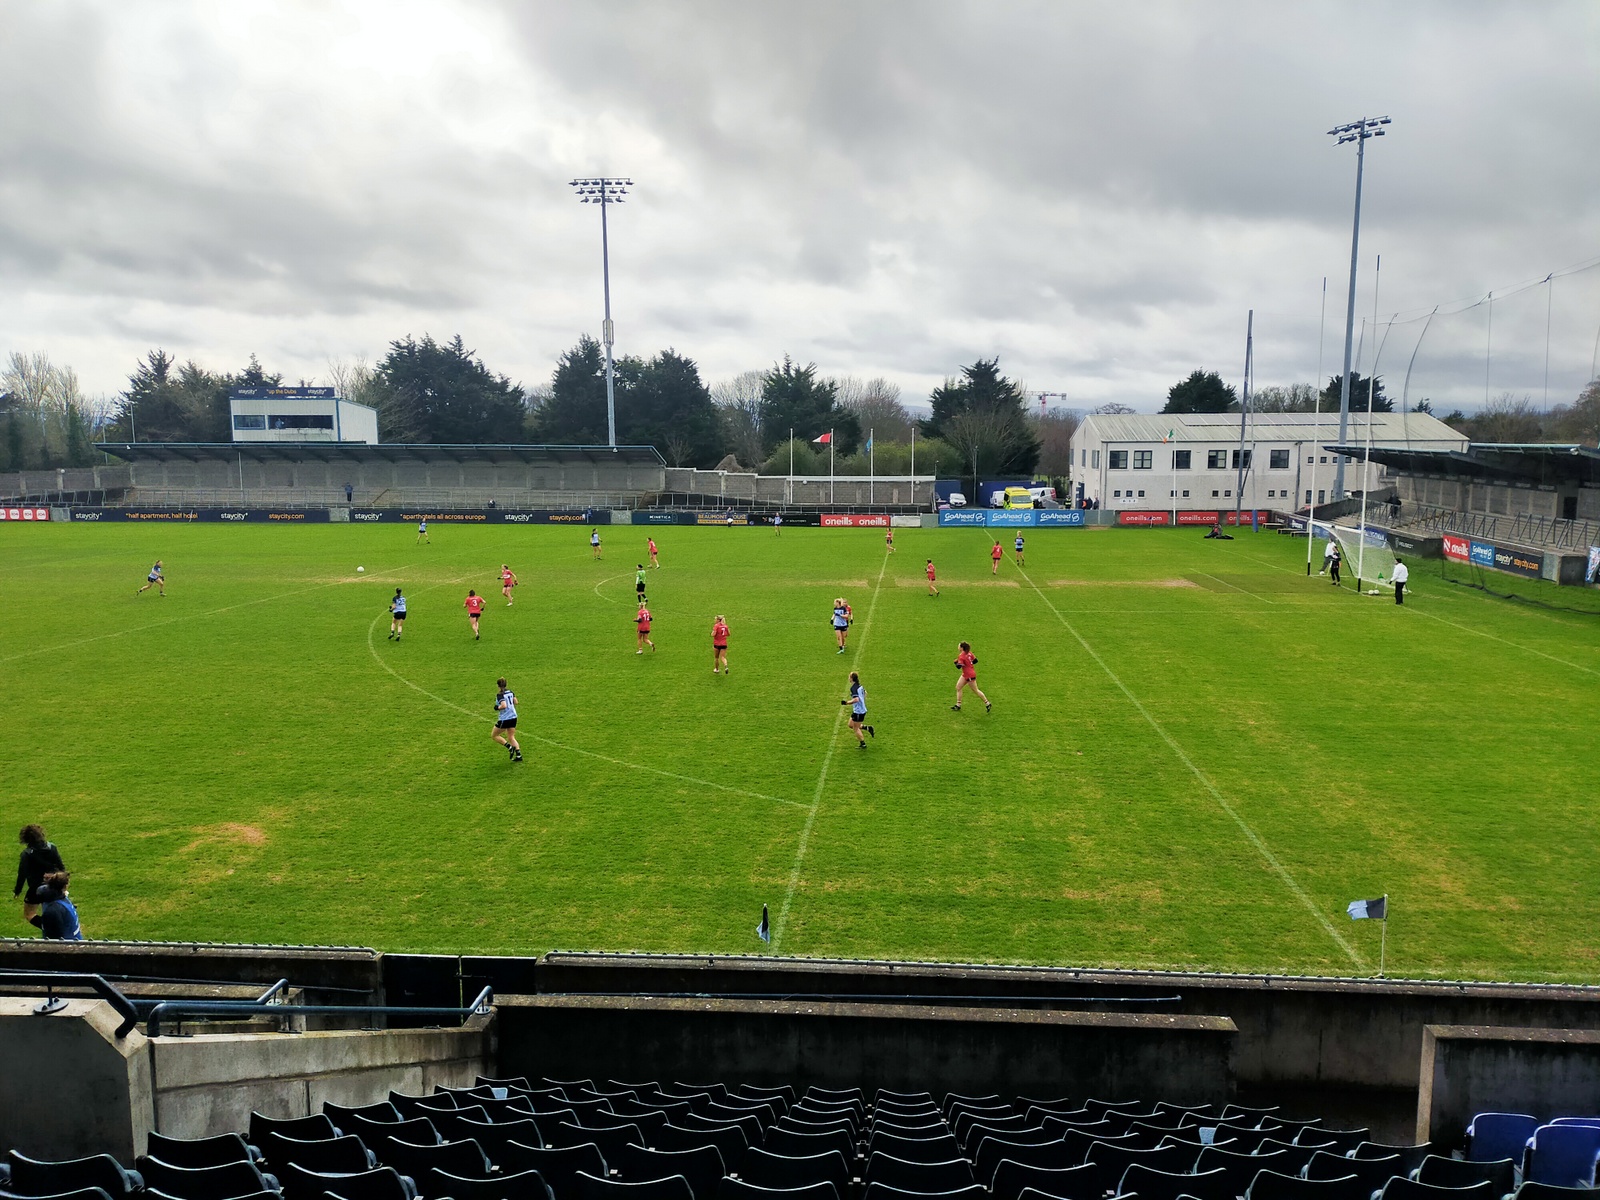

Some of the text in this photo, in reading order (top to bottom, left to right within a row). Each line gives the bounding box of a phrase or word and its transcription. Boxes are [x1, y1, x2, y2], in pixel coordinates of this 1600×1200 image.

[268, 513, 305, 521] staycity.com
[472, 599, 478, 607] 3
[721, 627, 726, 635] 7
